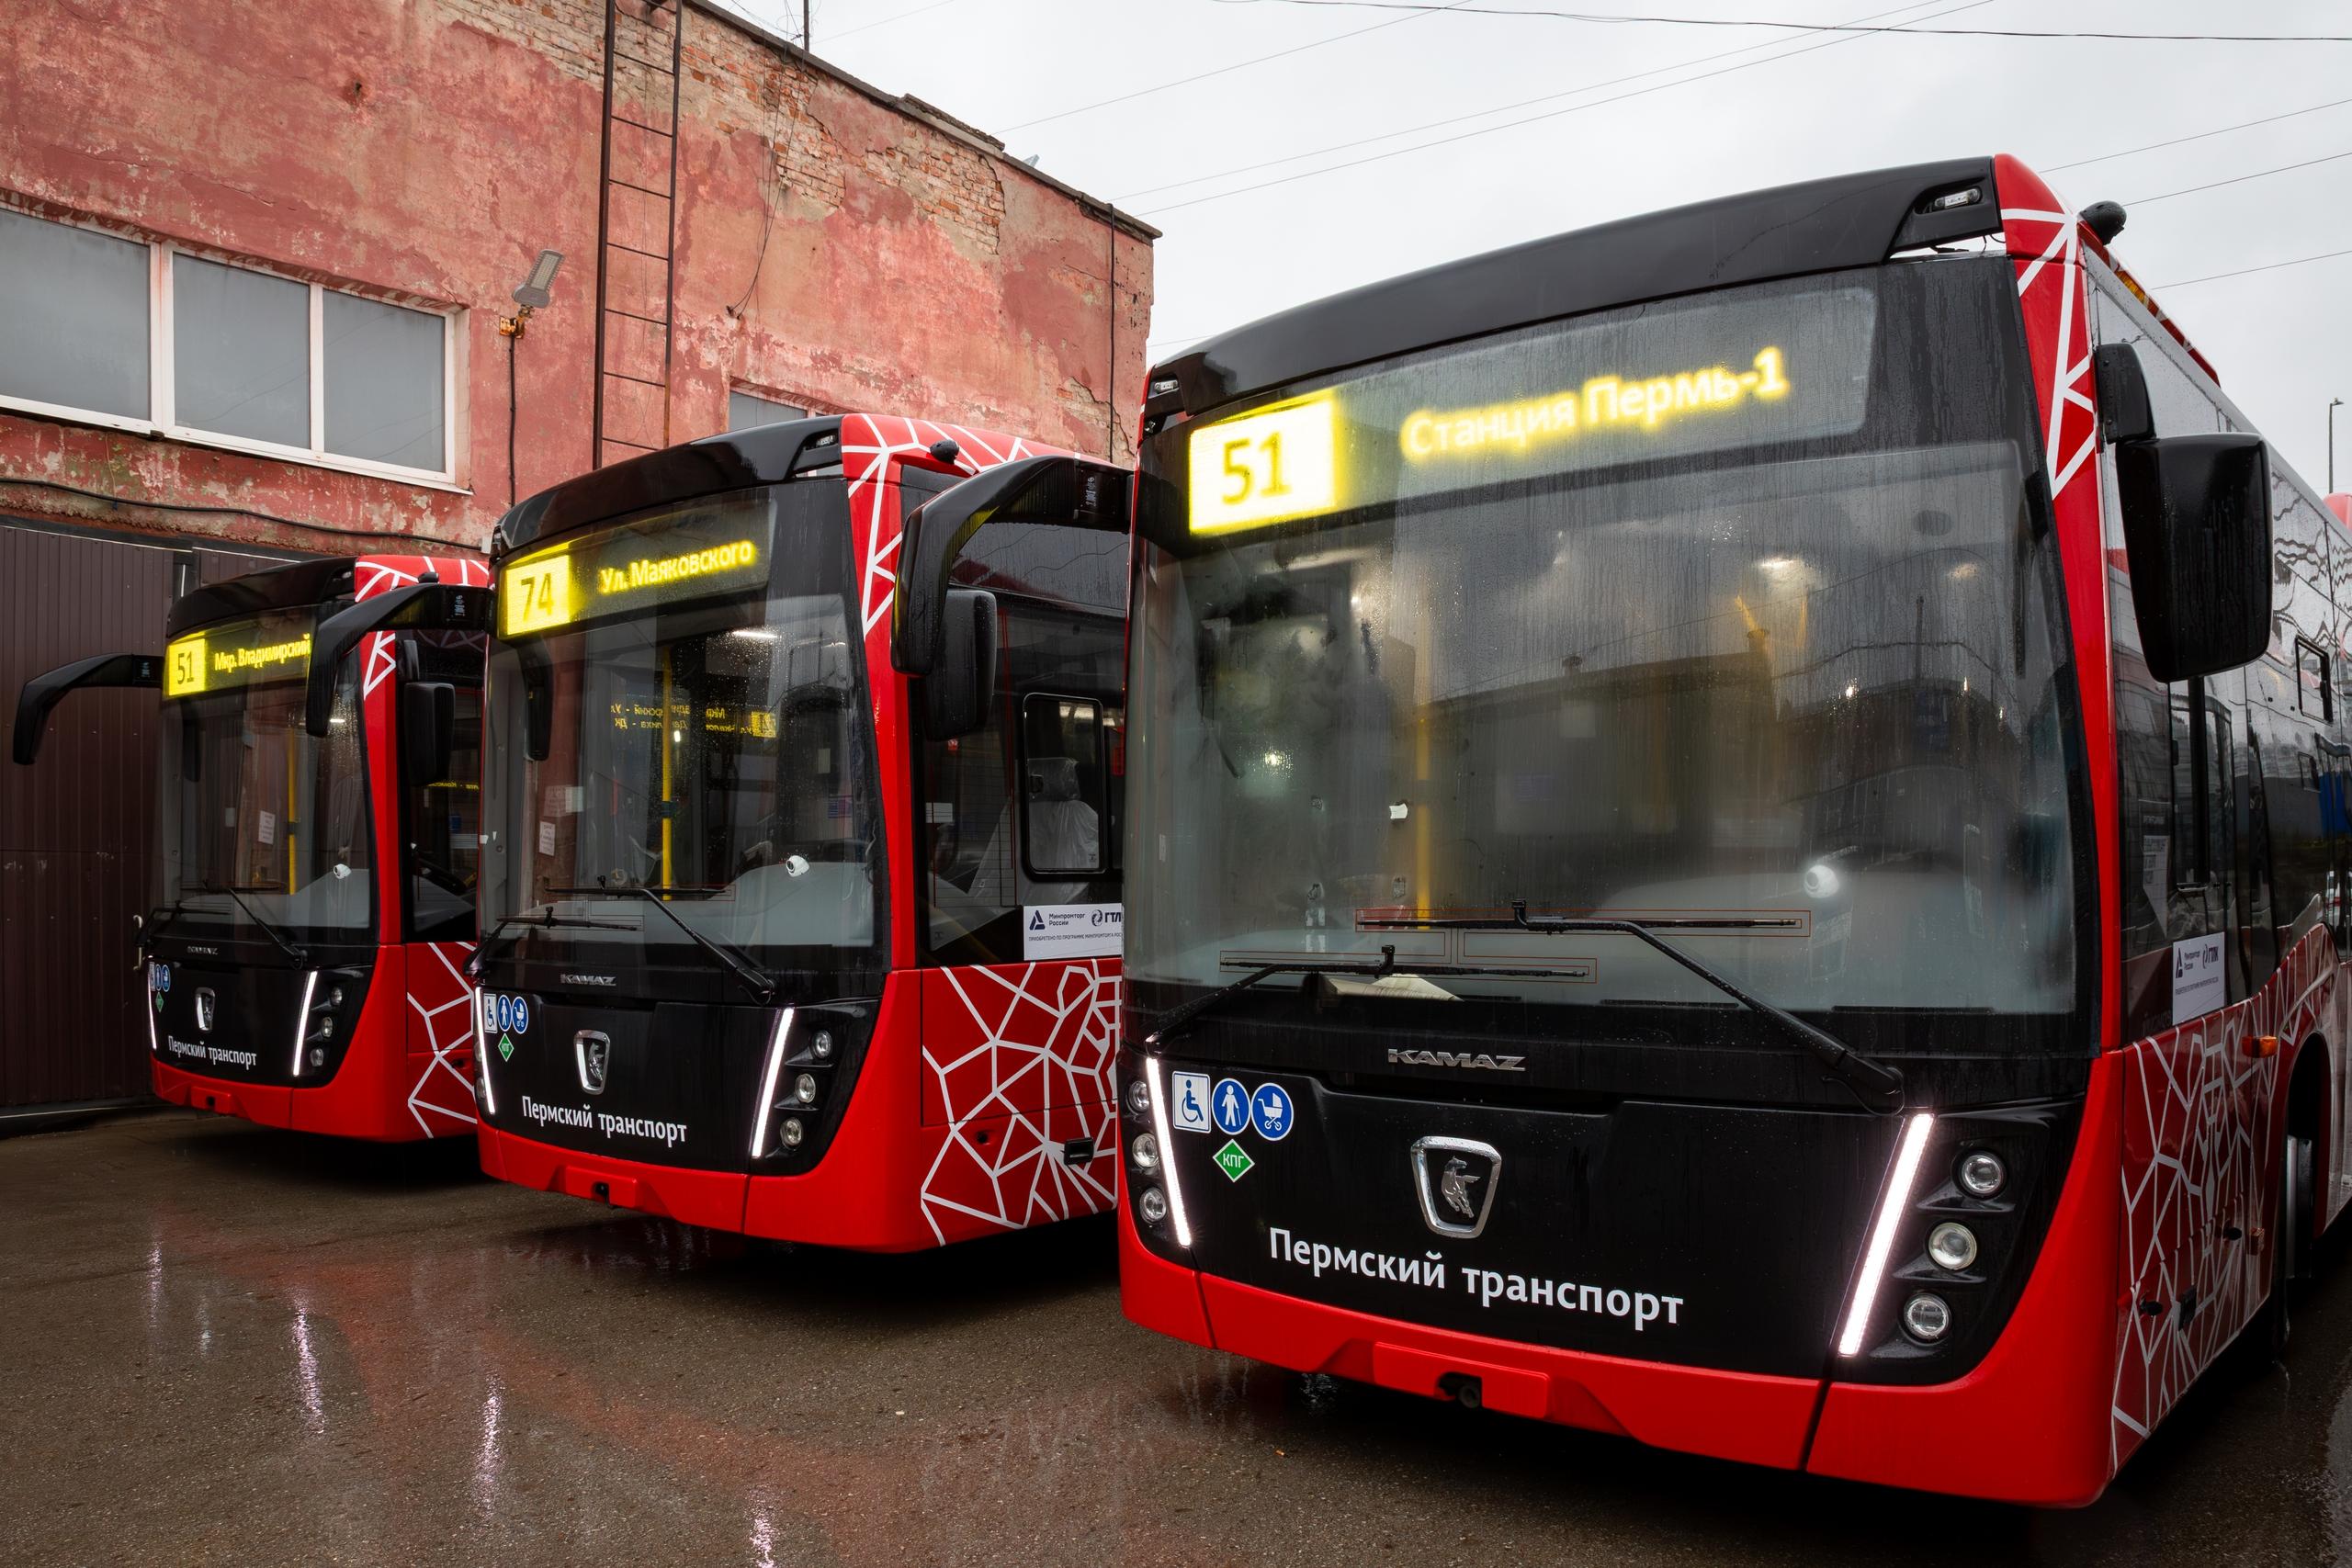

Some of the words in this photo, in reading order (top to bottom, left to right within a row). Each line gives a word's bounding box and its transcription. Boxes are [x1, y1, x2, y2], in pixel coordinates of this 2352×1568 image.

[1407, 392, 1575, 458] Станция
[1584, 346, 1788, 427] Пермь-1
[1220, 430, 1292, 505] 51
[602, 569, 628, 594] Ул.
[630, 540, 755, 585] Маяковского
[520, 571, 554, 623] 74
[176, 651, 195, 685] 51
[214, 650, 237, 672] Мкр.
[238, 633, 311, 668] Владимирский
[1048, 912, 1086, 920] Минпромторг
[1104, 911, 1122, 923] ГТЛ
[560, 973, 617, 987] KAMAZ
[168, 1035, 206, 1058] Пермский
[208, 1045, 257, 1071] транспорт
[1387, 1048, 1527, 1072] KAMAZ
[522, 1095, 593, 1129] Пермский
[597, 1112, 687, 1148] транспорт
[1221, 1150, 1245, 1169] КПГ
[1269, 1226, 1446, 1290] Пермский
[1461, 1264, 1685, 1331] транспорт
